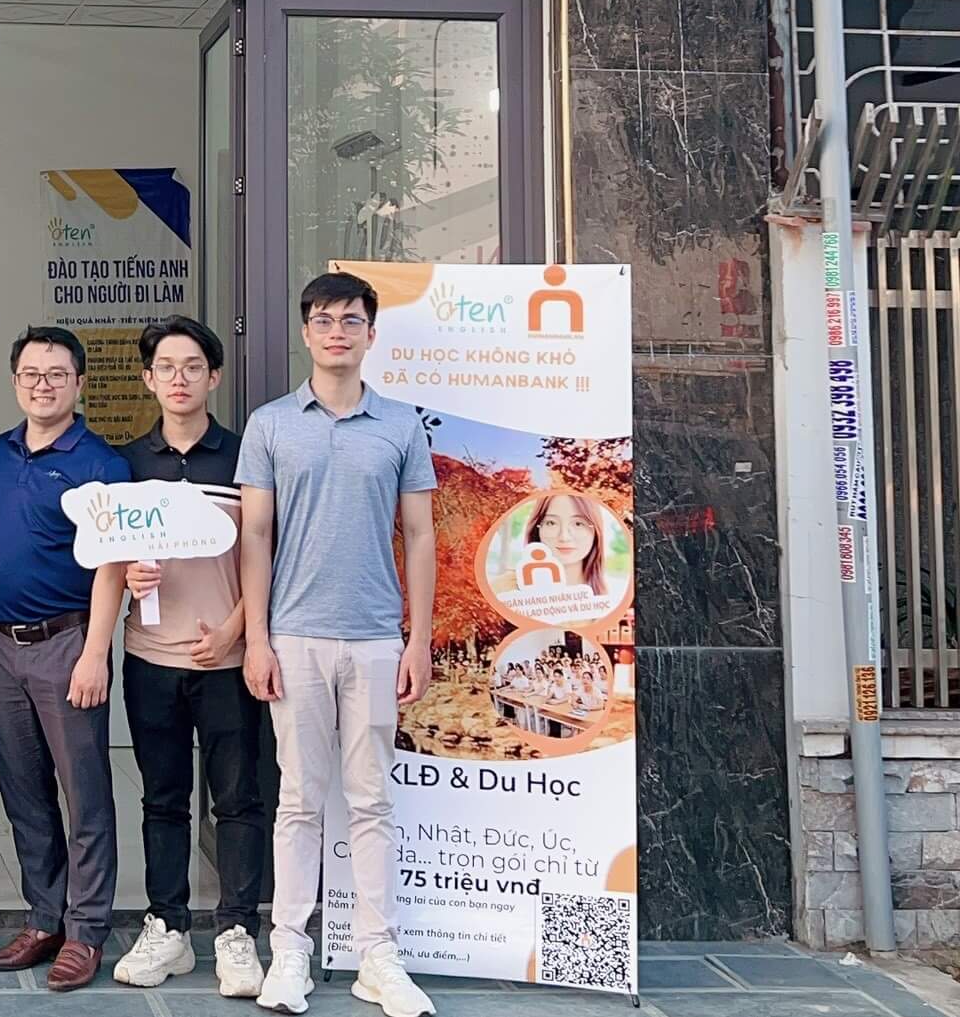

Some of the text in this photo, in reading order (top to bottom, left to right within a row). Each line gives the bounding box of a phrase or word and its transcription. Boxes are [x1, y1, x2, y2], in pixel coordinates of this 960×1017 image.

[48, 254, 188, 282] ĐÀO TẠO TIẾNG ANH
[54, 281, 184, 303] CHO NGƯỜI ĐI LÀM
[391, 347, 576, 365] DU HỌC KHÔNG KHÓ
[382, 368, 409, 384] ĐÃ
[415, 368, 442, 385] CÓ
[448, 372, 569, 389] HUMANBANK
[390, 762, 581, 801] KLĐ & Du Học
[418, 823, 477, 847] Nhật,
[484, 827, 535, 851] Đức,
[543, 828, 576, 854] Úc,
[438, 848, 485, 868] trọn
[493, 852, 526, 874] gói
[534, 855, 567, 874] chỉ
[576, 858, 599, 877] từ
[400, 869, 540, 896] 75 triệu vnđ
[414, 895, 426, 904] lai
[449, 899, 466, 907] con
[469, 898, 487, 909] bạn
[490, 902, 515, 912] ngay
[403, 929, 423, 937] xem
[427, 928, 455, 941] thông
[458, 931, 470, 940] tin
[418, 950, 430, 958] ưu
